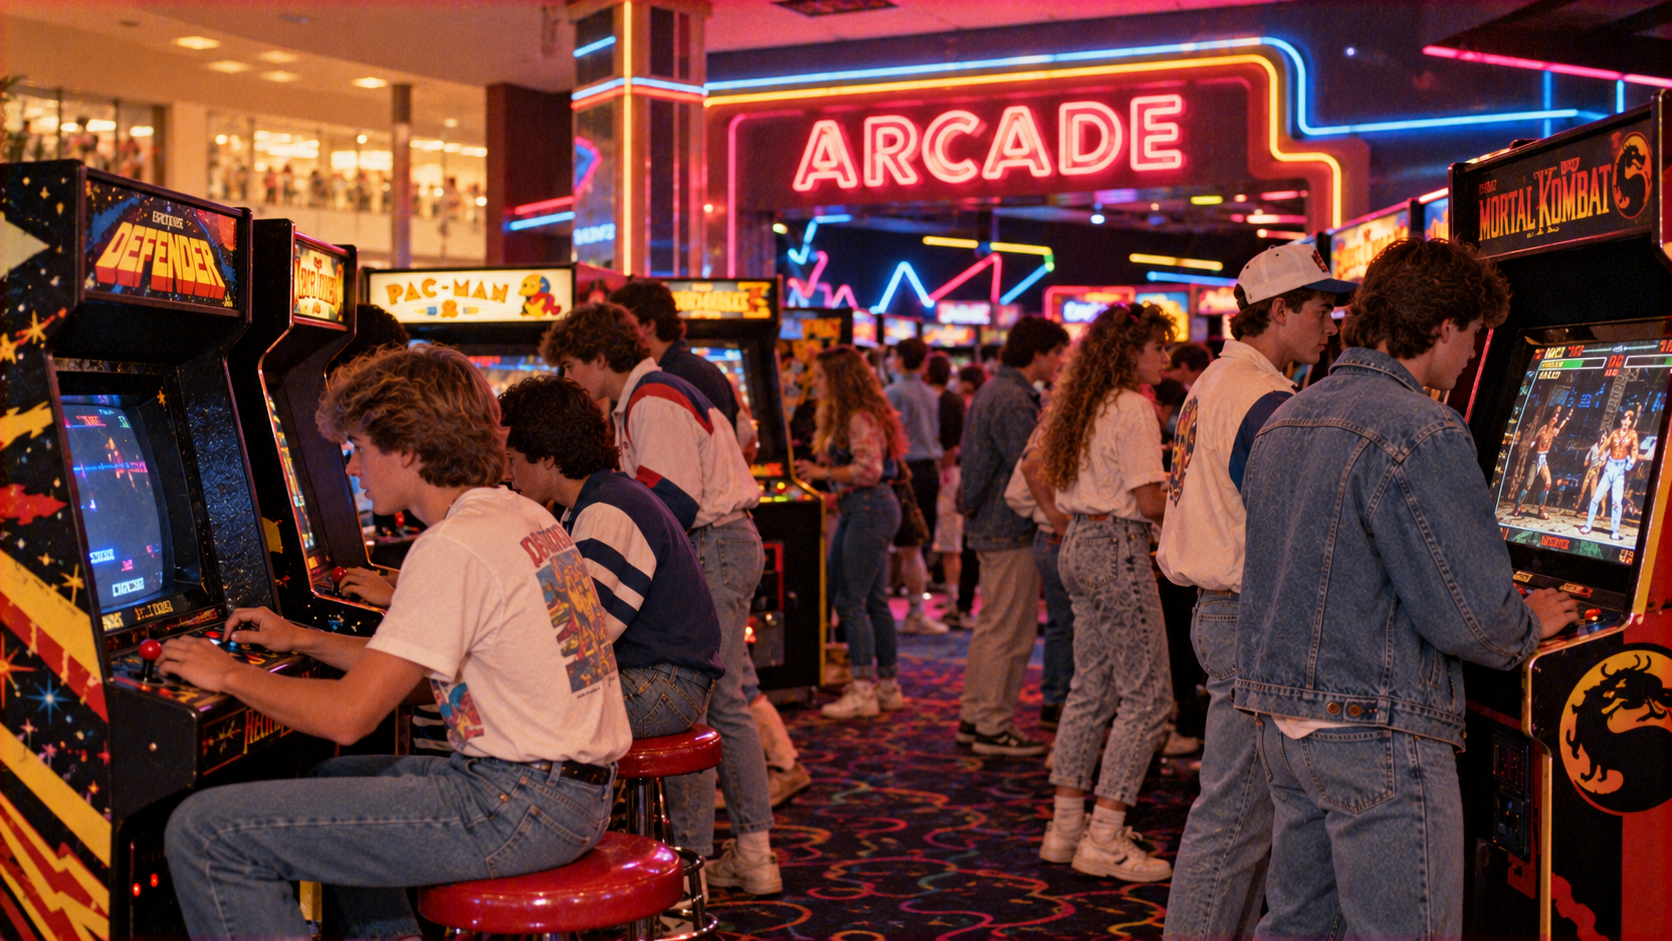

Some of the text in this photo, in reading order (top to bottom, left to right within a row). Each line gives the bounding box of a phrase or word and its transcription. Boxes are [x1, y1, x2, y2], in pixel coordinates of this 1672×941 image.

[792, 93, 1184, 192] ARCADE
[1478, 186, 1536, 242] MORTAL
[1533, 163, 1613, 229] KOMBAT
[95, 221, 226, 300] DEFENDER
[385, 277, 510, 306] PAC-MAN
